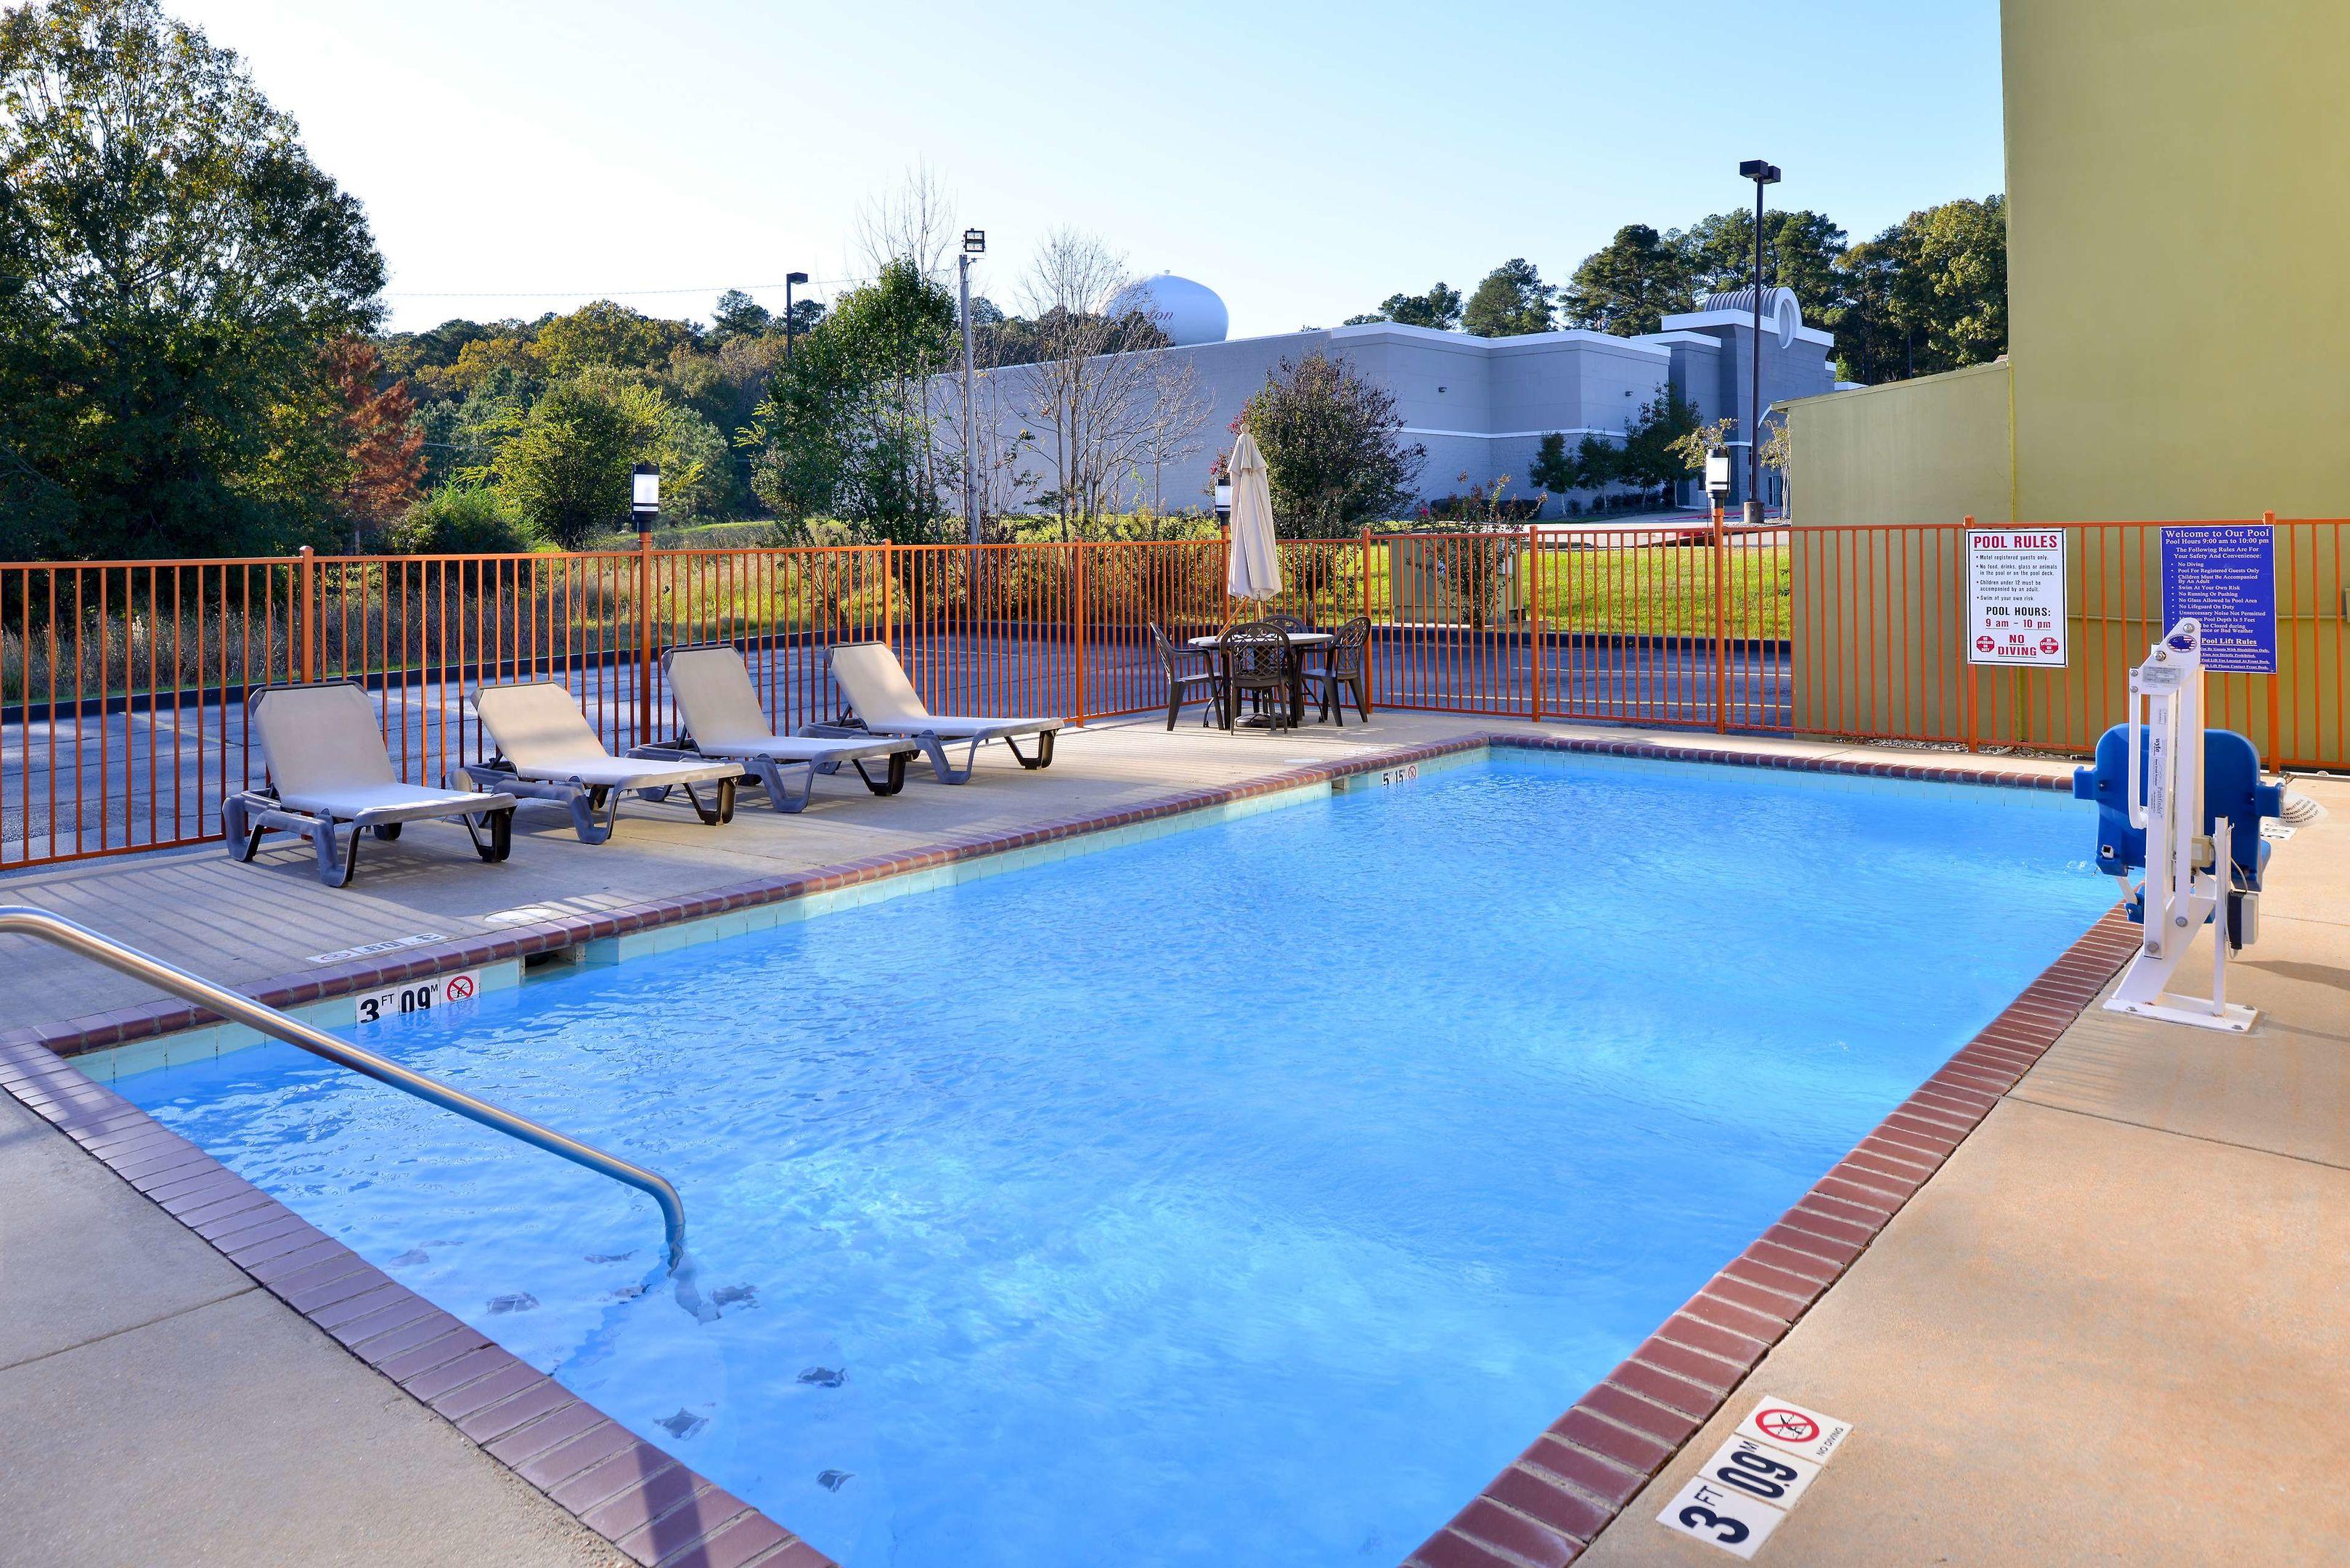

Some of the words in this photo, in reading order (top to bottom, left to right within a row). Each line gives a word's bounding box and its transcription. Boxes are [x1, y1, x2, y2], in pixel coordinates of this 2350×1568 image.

[1974, 536, 2007, 548] POOL
[2015, 535, 2057, 548] RULES
[1986, 606, 2010, 616] POOL
[2015, 607, 2051, 616] HOURS:
[1986, 618, 1991, 627] 9
[2023, 619, 2032, 628] 10
[2010, 634, 2025, 643] NO
[1998, 646, 2036, 656] DIVING
[1384, 772, 1390, 785] 5
[360, 998, 380, 1024] 3
[381, 993, 394, 1006] FT
[431, 984, 438, 992] M
[1739, 1440, 1760, 1453] M
[1816, 1445, 1829, 1458] NO
[1826, 1426, 1844, 1447] DIVING
[1694, 1485, 1723, 1507] FT
[1678, 1505, 1750, 1544] 3
